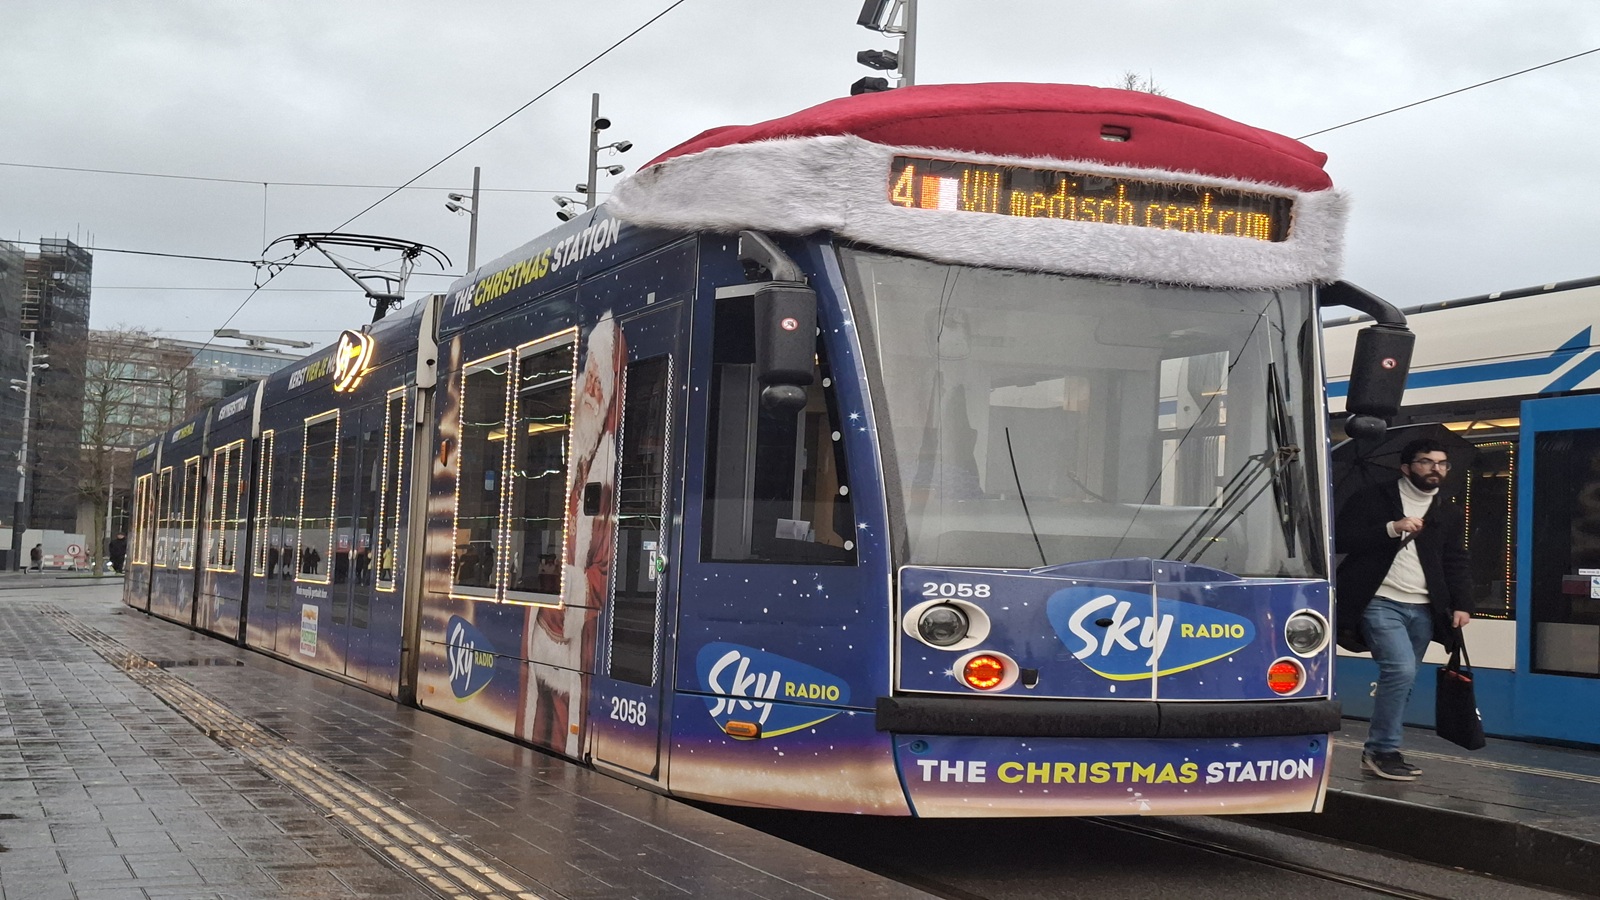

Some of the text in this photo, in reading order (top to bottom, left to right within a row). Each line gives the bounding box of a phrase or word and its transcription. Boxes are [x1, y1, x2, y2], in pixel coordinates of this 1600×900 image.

[892, 164, 915, 208] 4
[1010, 178, 1134, 226] medisch
[1146, 192, 1270, 241] centrum
[452, 217, 622, 317] THE CHRISTMAS STATION
[922, 582, 992, 599] 2058
[449, 622, 494, 692] Sky RADIO
[1068, 594, 1245, 667] Sky RADIO
[610, 696, 647, 727] 2058
[708, 650, 840, 725] Sky RADIO
[917, 758, 1314, 785] THE CHRISTMAS STATION
